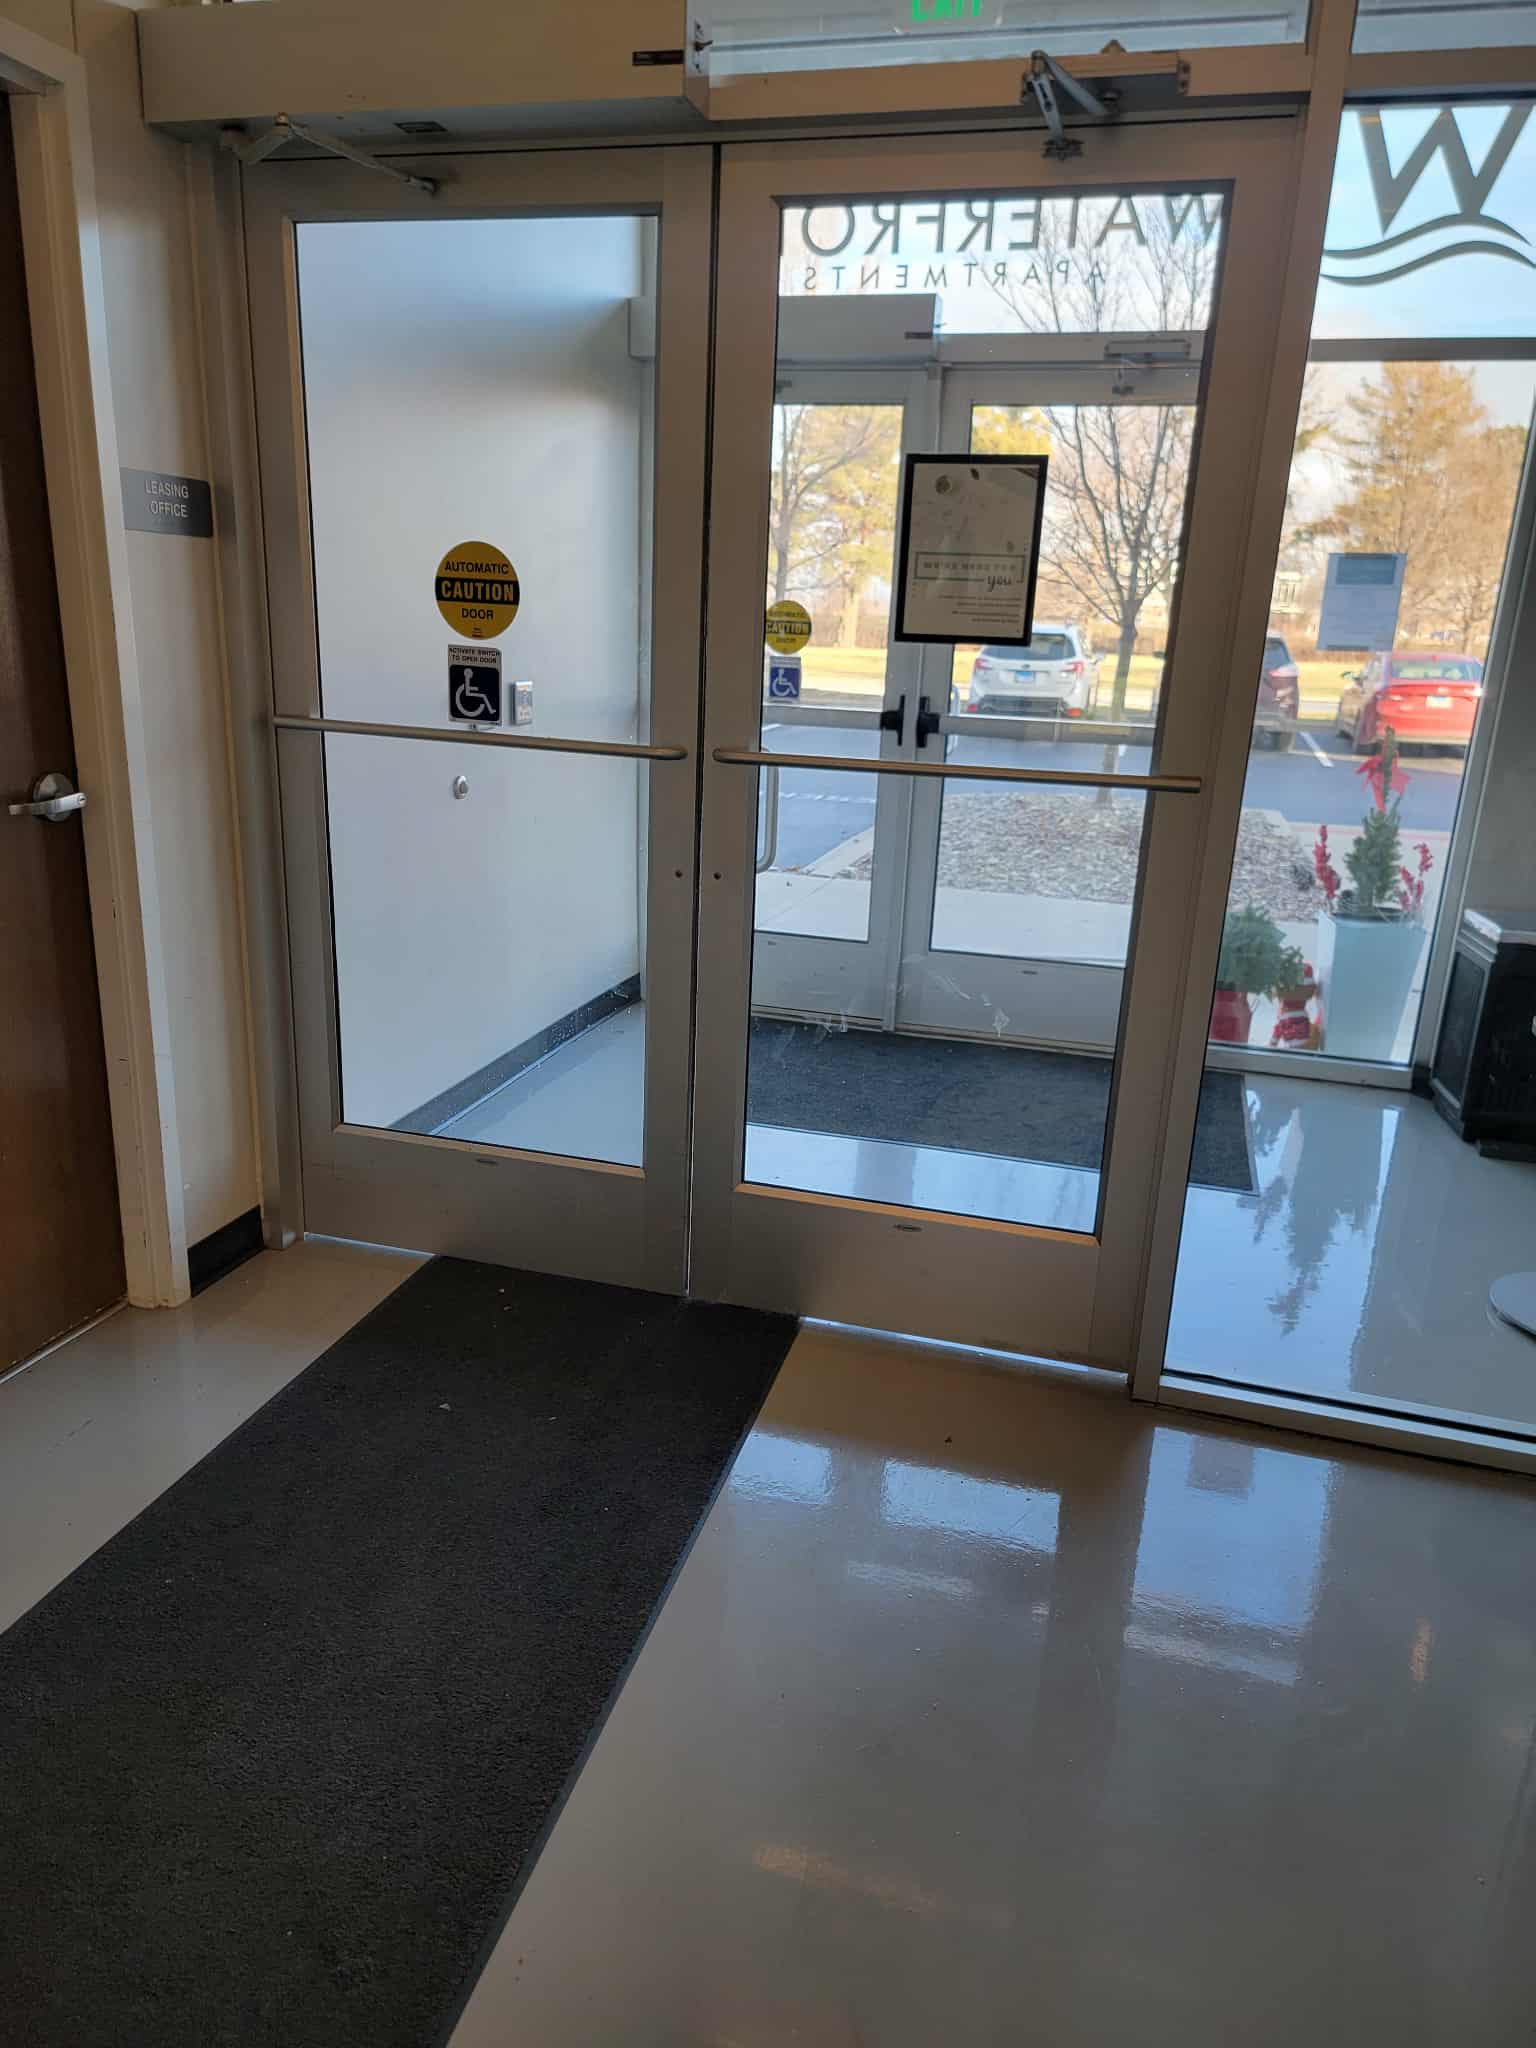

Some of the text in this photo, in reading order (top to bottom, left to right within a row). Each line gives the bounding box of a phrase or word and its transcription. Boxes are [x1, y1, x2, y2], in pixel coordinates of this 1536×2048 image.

[144, 479, 190, 498] LEASING
[150, 500, 189, 518] OFFICE
[444, 561, 509, 574] AUTOMATIC
[441, 580, 514, 602] CAUTION
[461, 607, 494, 621] DOOR
